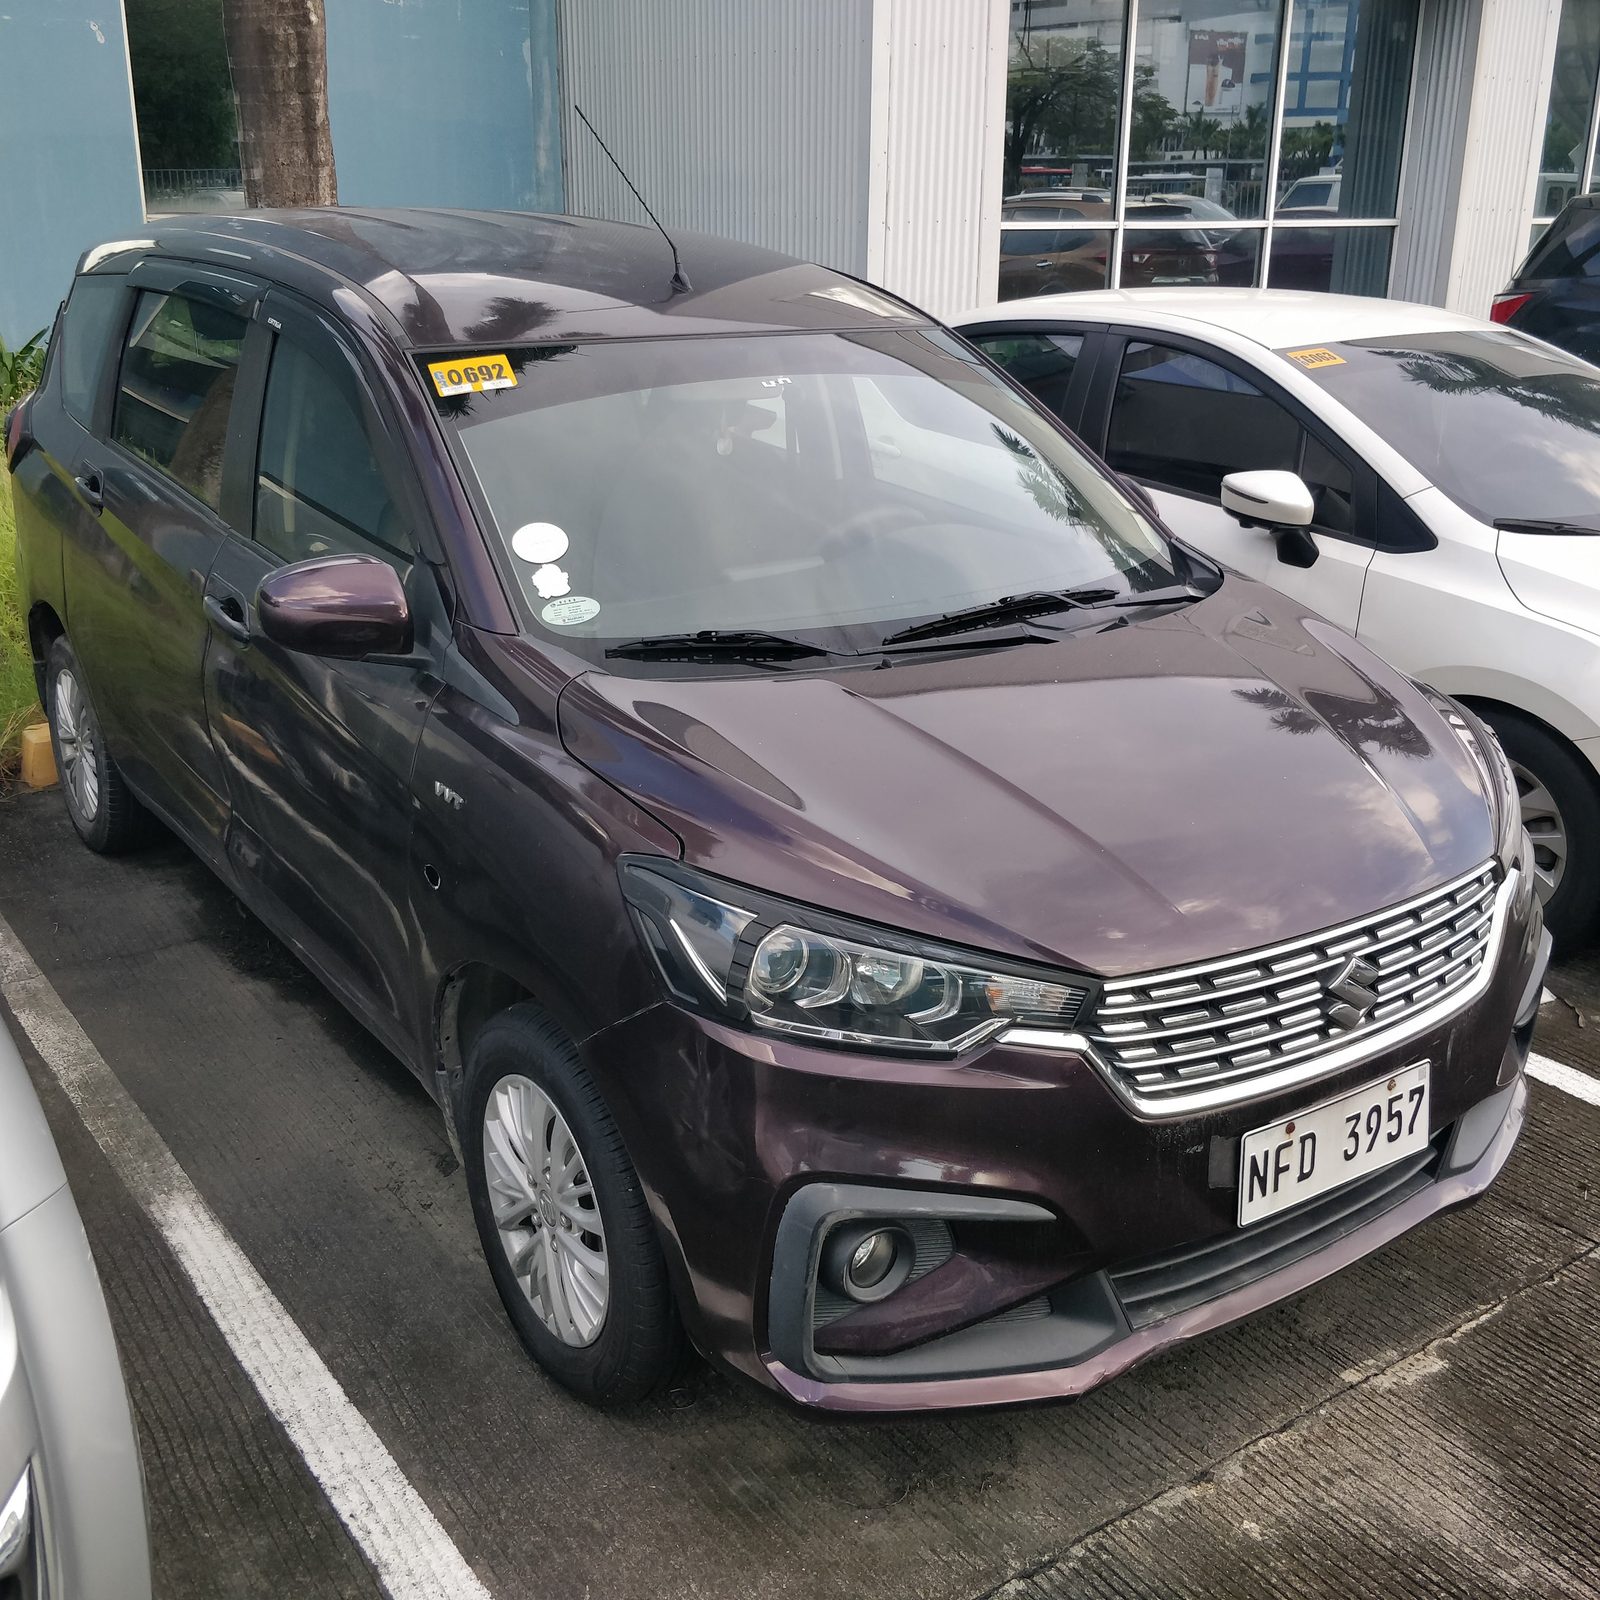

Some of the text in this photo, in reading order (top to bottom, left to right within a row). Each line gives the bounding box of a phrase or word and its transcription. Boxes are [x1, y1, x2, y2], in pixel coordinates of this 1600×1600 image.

[447, 364, 508, 385] 0692
[434, 780, 464, 810] VVT
[1248, 1085, 1425, 1203] NFD 3957
